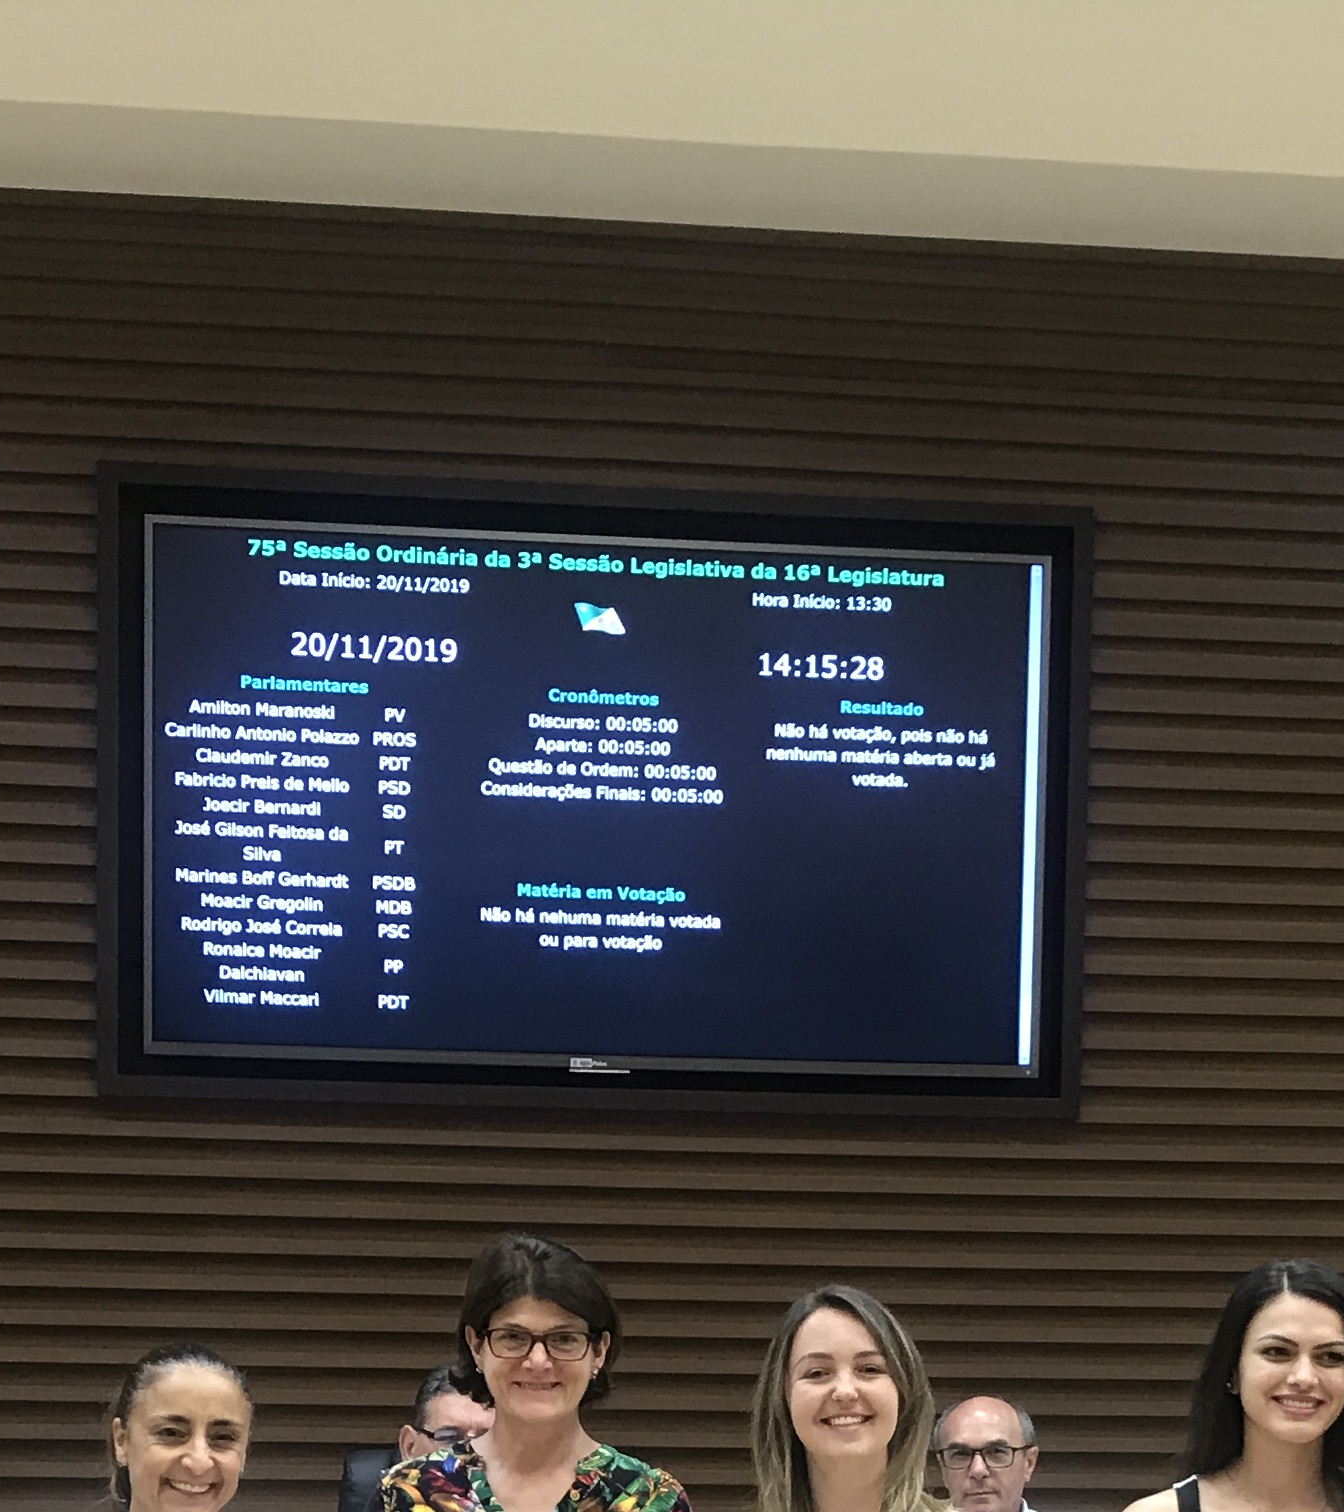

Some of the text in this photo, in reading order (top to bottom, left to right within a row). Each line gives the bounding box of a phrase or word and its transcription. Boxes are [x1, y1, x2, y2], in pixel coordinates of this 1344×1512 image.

[248, 539, 944, 587] 75ª Sessão Ordinária da 3ª Sessão Legislativa da 16ª Legislatura
[279, 571, 470, 594] Data Início: 20/11/2019
[752, 593, 892, 612] Hora Início: 13:30
[291, 632, 458, 663] 20/11/2019
[759, 653, 884, 681] 14:15:28
[241, 675, 369, 694] Parlamentares
[548, 688, 659, 706] Cronômetros
[189, 699, 335, 719] Amilton Maranoski
[385, 708, 406, 722] PV
[840, 700, 924, 716] Resultado
[529, 713, 678, 733] Discurso: 00:05:00
[165, 722, 360, 745] Carlinho Antonio Polazzo
[373, 731, 416, 747] PROS
[774, 723, 988, 744] Não há votação, pois não há
[535, 737, 670, 756] Aparte: 00:05:00
[196, 748, 329, 768] Claudemir Zanco
[379, 756, 411, 771] PDT
[766, 747, 996, 770] nenhuma matéria aberta ou já
[489, 758, 716, 781] Questão de Ordem: 00:05:00
[175, 772, 350, 793] Fabricio Preis de Mello
[379, 780, 411, 795] PSD
[852, 773, 908, 788] votada.
[481, 781, 723, 804] Considerações Finais: 00:05:00
[203, 797, 321, 816] Joecir Bernardi
[383, 804, 406, 819] SD
[175, 820, 348, 841] José Gilson Feitosa da
[243, 846, 281, 862] Silva
[385, 840, 405, 854] PT
[176, 868, 349, 888] Marines Boff Gerhardt
[373, 875, 416, 891] PSDB
[517, 883, 685, 904] Matéria em Votação
[201, 893, 323, 914] Moacir Gregolin
[376, 900, 412, 915] MDB
[181, 917, 342, 937] Rodrigo José Correia
[480, 907, 721, 929] Não há nehuma matéria votada
[378, 924, 410, 939] PSC
[203, 941, 322, 959] Ronalce Moacir
[539, 935, 662, 953] ou para votação
[219, 965, 304, 982] Dalchiavan
[384, 959, 404, 974] PP
[204, 989, 319, 1007] Vilmar Maccari
[378, 995, 410, 1010] PDT
